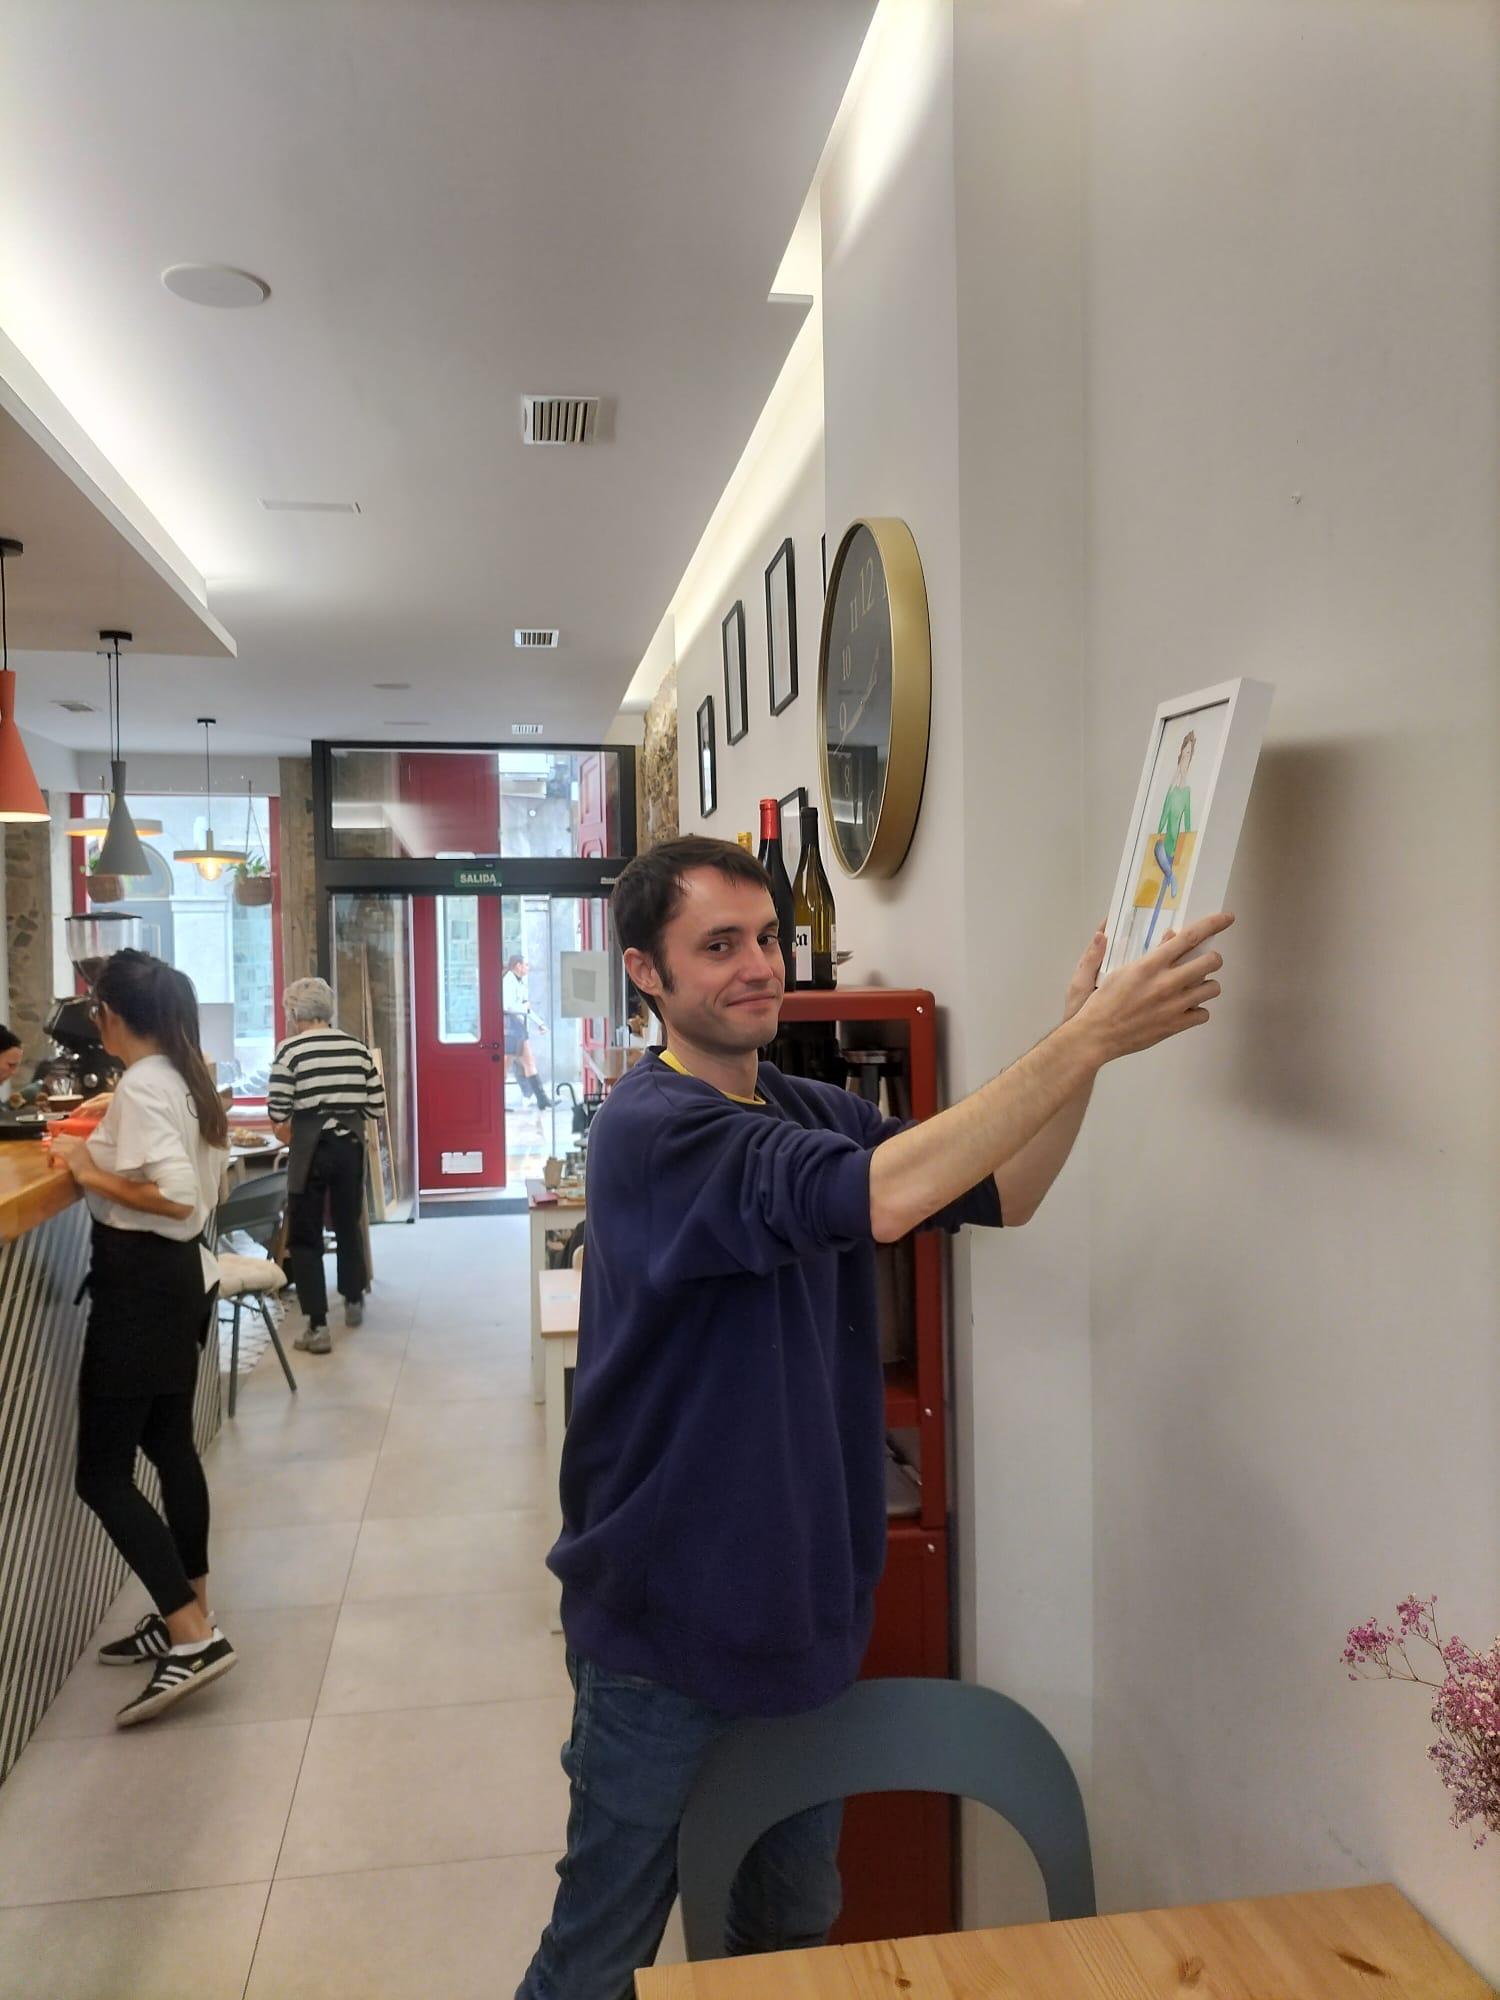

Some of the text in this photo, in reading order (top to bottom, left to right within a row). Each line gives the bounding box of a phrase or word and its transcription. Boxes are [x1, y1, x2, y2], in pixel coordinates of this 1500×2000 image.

[860, 558, 874, 616] 12
[850, 596, 858, 632] 11
[842, 644, 851, 680] 10
[460, 873, 496, 884] SALIDA
